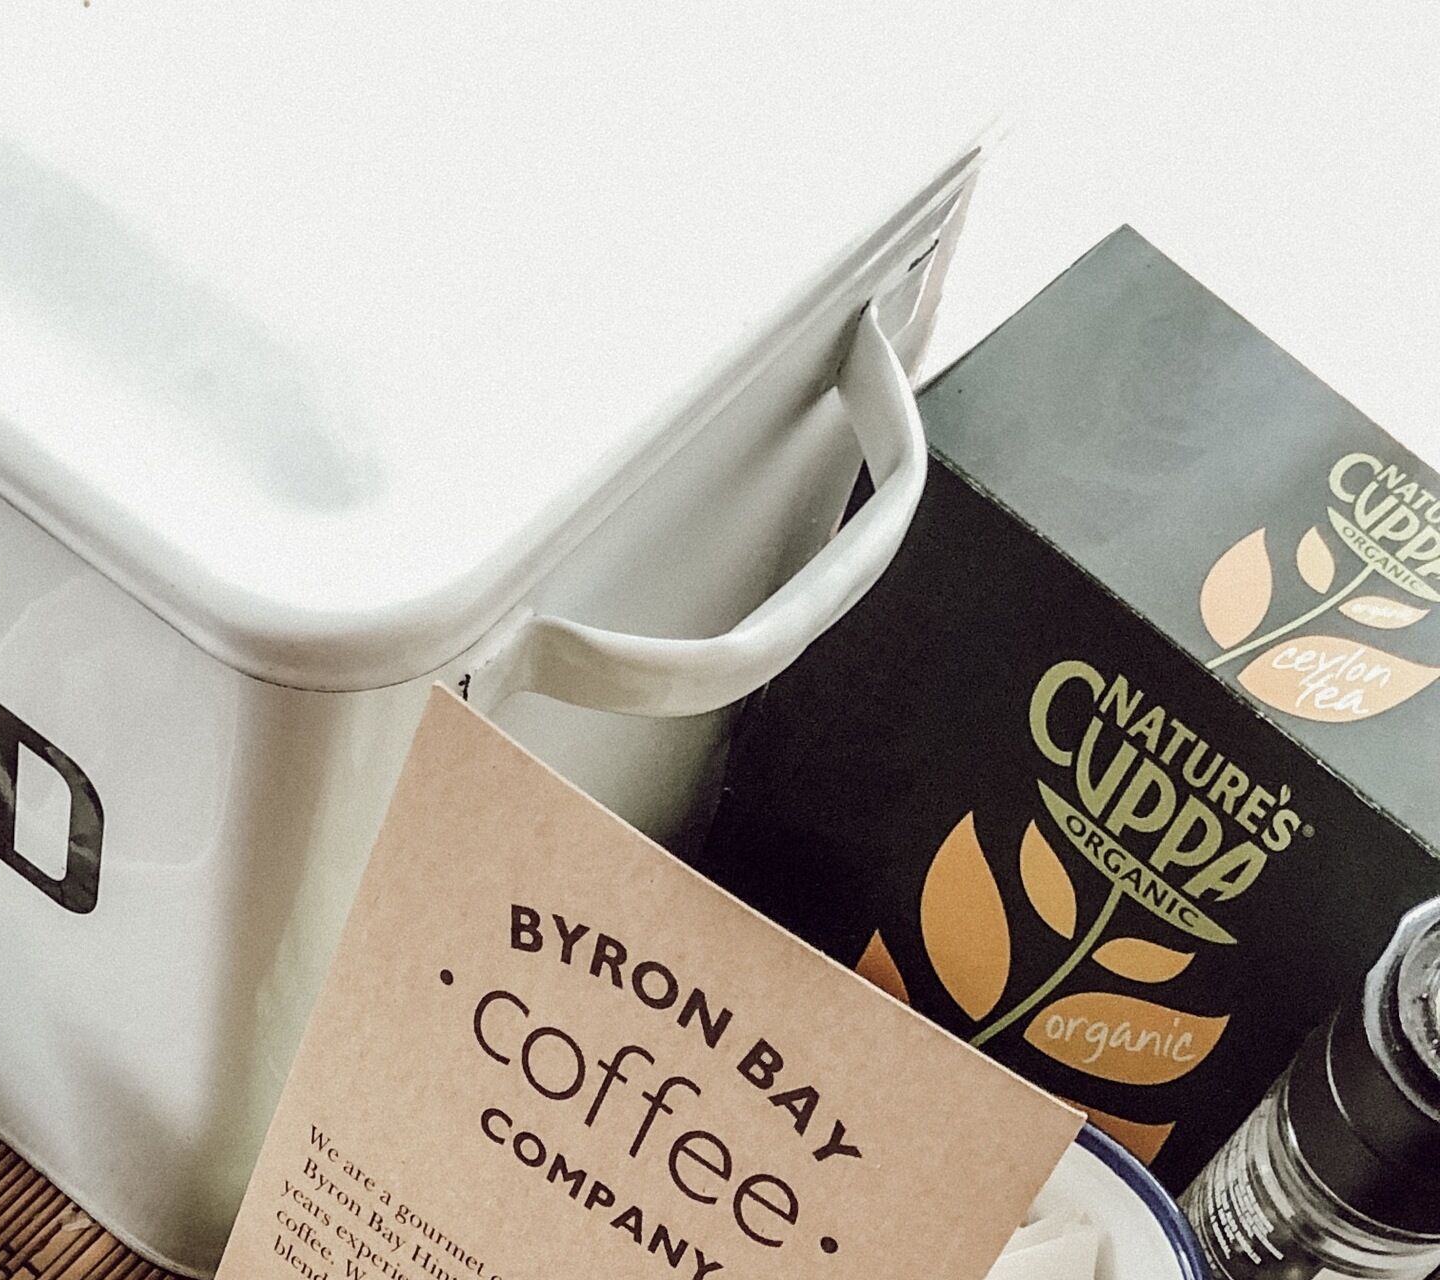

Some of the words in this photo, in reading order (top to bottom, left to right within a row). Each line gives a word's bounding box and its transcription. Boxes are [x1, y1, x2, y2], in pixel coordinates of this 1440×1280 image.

[1342, 525, 1421, 592] ORGANIC
[1271, 643, 1393, 690] ceylon
[1297, 679, 1370, 717] tea
[1028, 659, 1267, 902] CUPPA
[1098, 673, 1301, 853] NATURE'S
[1066, 814, 1197, 928] ORGANIC
[510, 903, 732, 1048] BYRON
[737, 1039, 862, 1167] BAY
[1045, 1011, 1196, 1063] organic
[473, 990, 801, 1248] coffee
[275, 1209, 335, 1266] coffee.
[279, 1178, 331, 1227] years
[302, 1155, 362, 1217] Byron
[366, 1209, 406, 1253] Bay
[309, 1123, 339, 1163] We
[341, 1159, 376, 1192] are
[378, 1189, 392, 1207] a
[393, 1202, 485, 1277] gourmet
